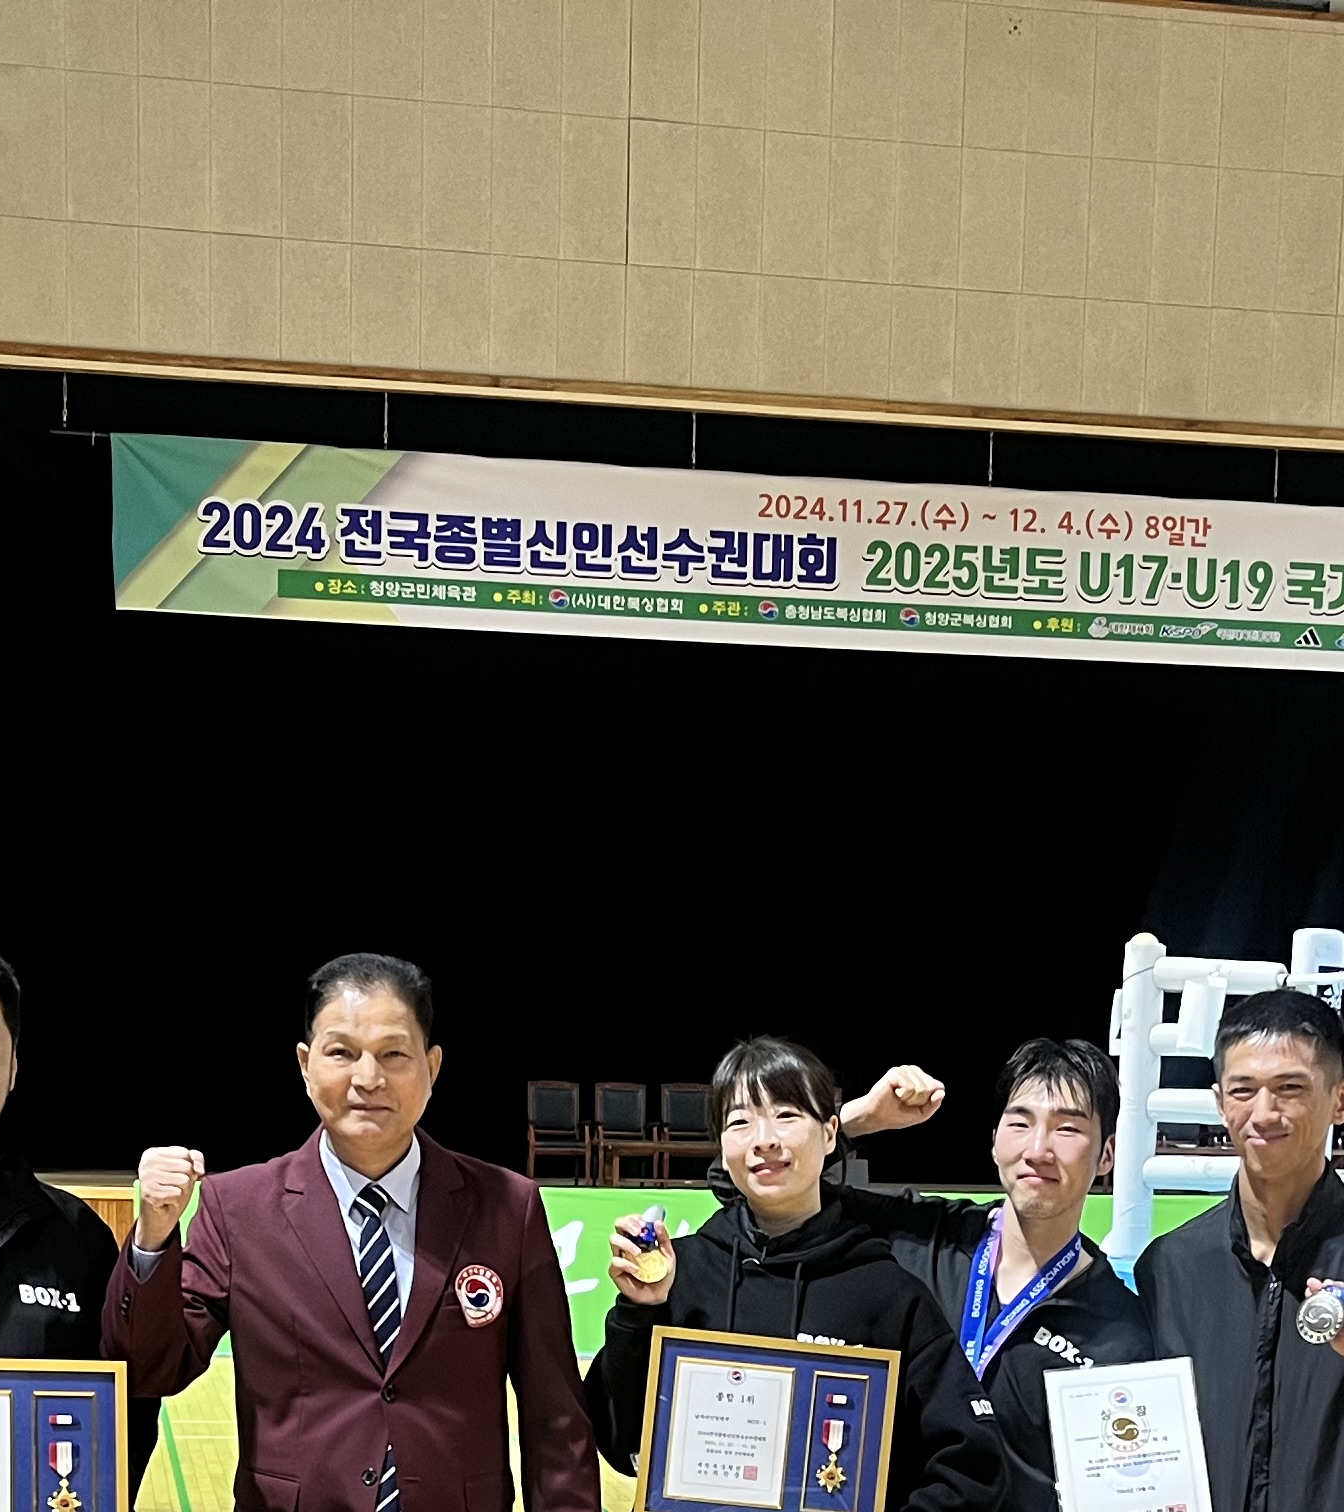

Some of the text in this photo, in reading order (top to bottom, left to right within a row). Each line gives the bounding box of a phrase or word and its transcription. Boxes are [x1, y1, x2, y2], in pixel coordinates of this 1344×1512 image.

[758, 493, 970, 532] 2024.11.27.(수)
[1010, 507, 1046, 533] 12.
[1057, 509, 1133, 541] 4.(수)
[1144, 515, 1212, 548] 8일간
[201, 501, 326, 554] 2024
[339, 507, 838, 585] 전국종별신인선수권대회
[864, 539, 1064, 597] 2025년도
[369, 581, 477, 602] 청양군민체육관
[571, 593, 684, 614] (사)대한복싱협회
[784, 604, 887, 624] 충청남도복싱협회
[924, 611, 1013, 629] 청양군복싱협회
[18, 1284, 81, 1312] BOX-1
[972, 1279, 984, 1318] BOXING
[1001, 1298, 1030, 1326] BOXING
[1029, 1250, 1075, 1300] ASSOCIATION
